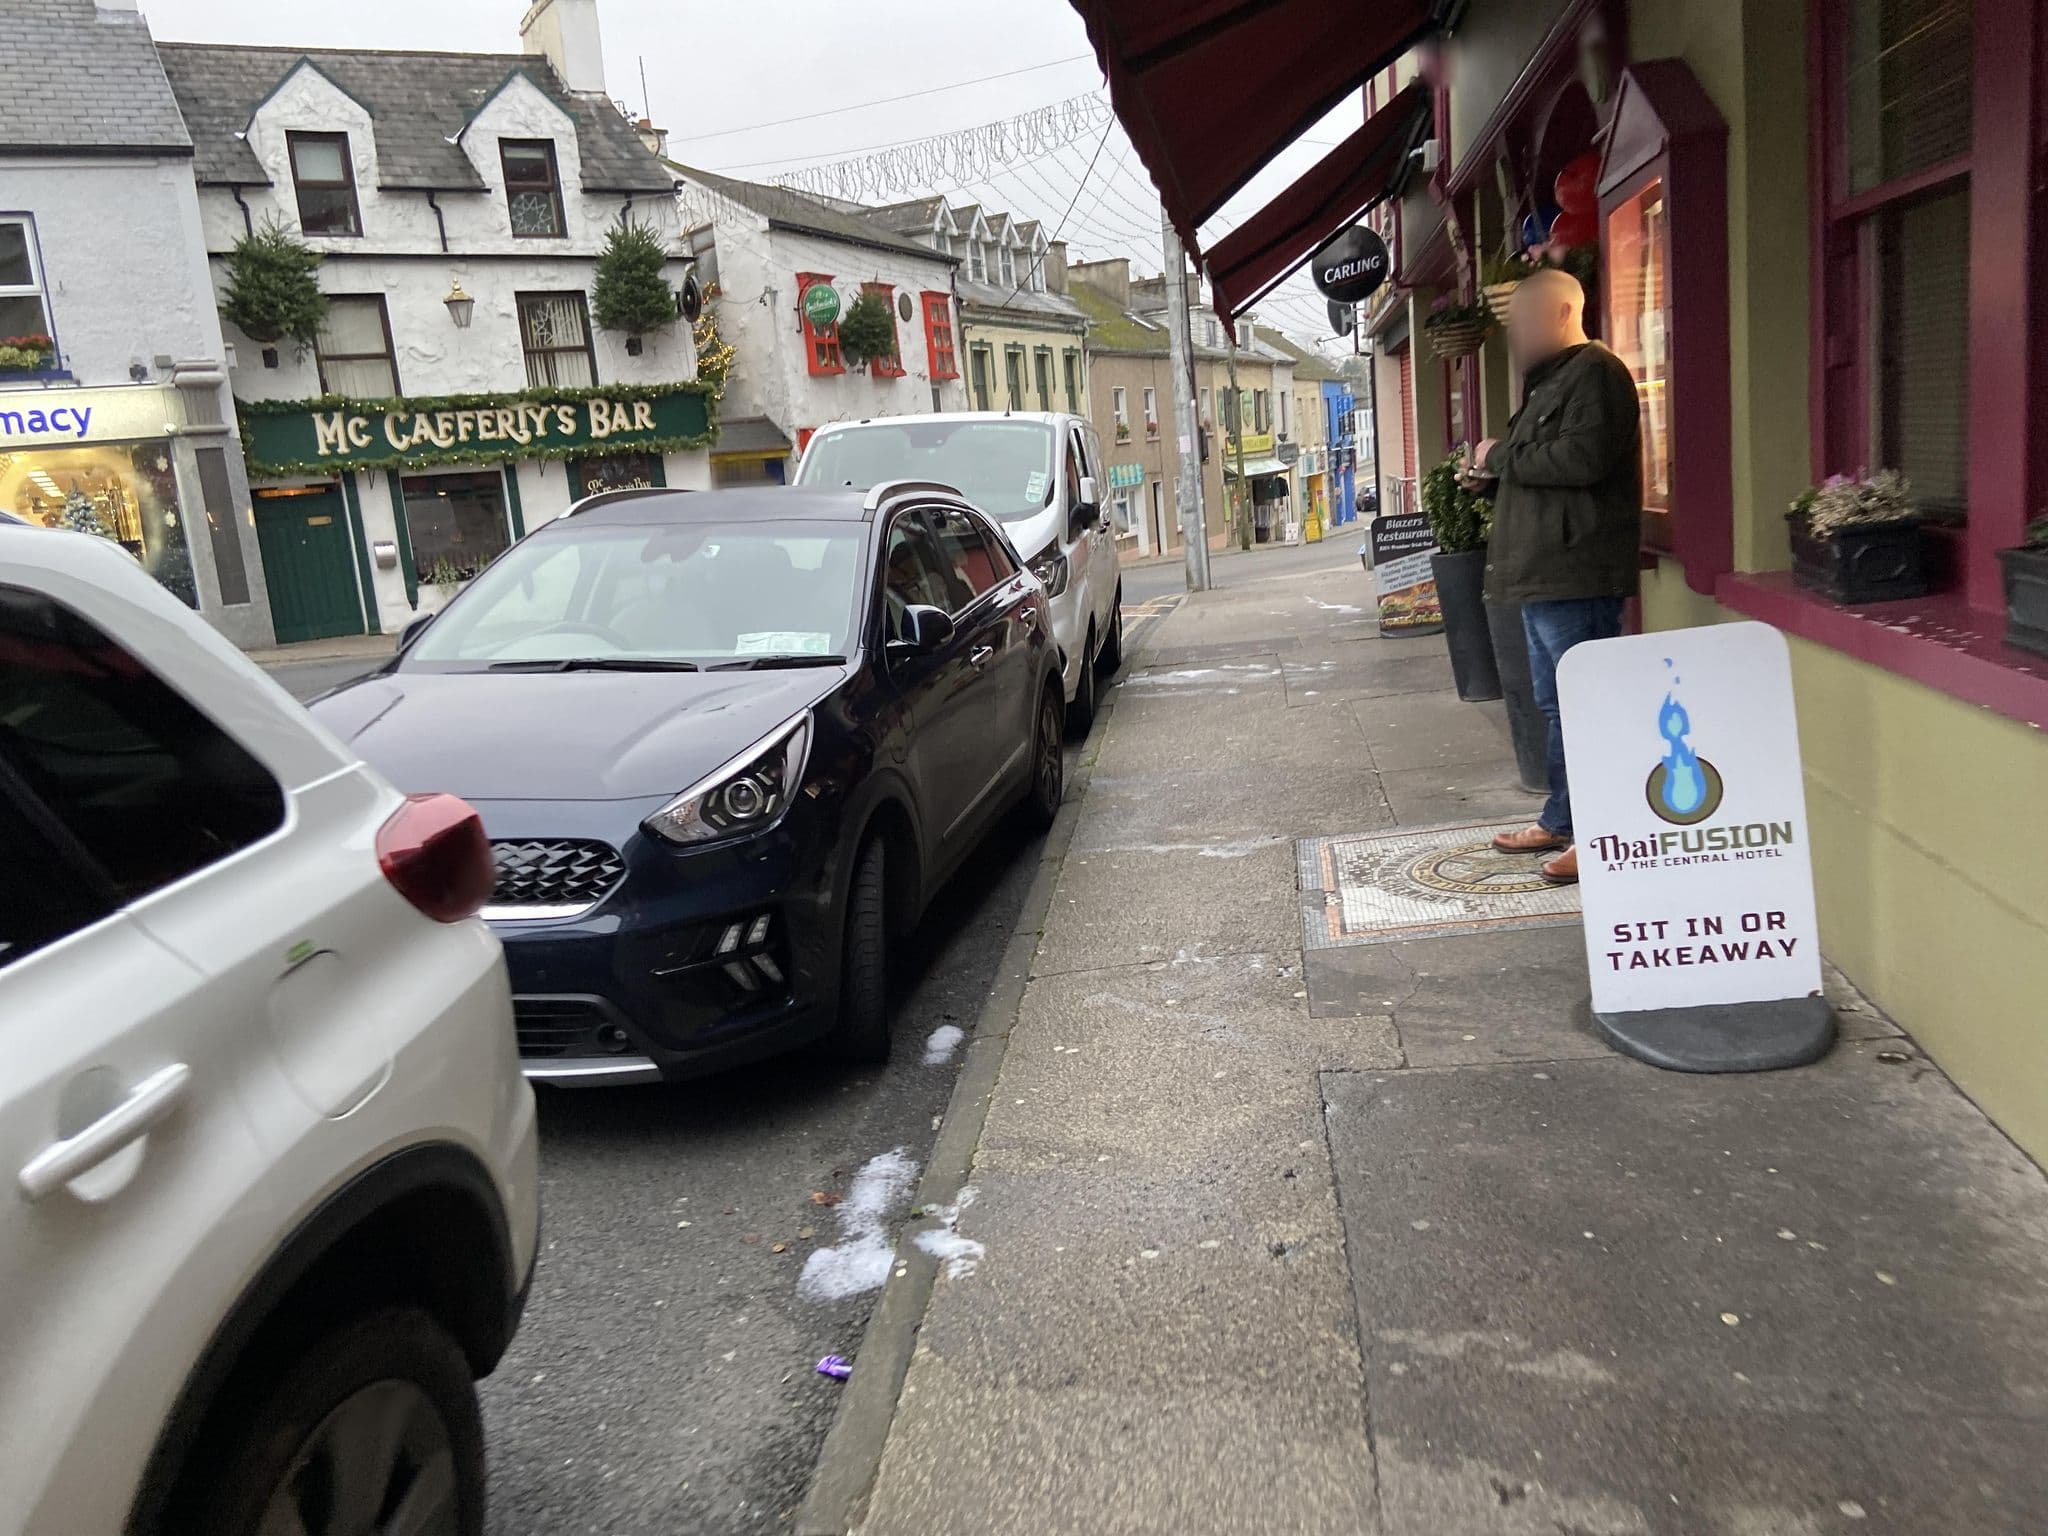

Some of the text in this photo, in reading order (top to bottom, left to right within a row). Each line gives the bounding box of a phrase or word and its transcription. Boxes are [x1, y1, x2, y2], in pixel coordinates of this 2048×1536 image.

[1324, 255, 1380, 284] CARLING
[383, 402, 577, 453] CAFFERTY'S
[587, 398, 657, 439] BAR
[1377, 528, 1434, 543] Restaurant
[1386, 517, 1423, 530] Blazers
[1607, 848, 1783, 872] AT THE CENTRAL HOTEL
[1614, 910, 1787, 943] SIT IN OR
[1607, 938, 1798, 971] TAKEAWAY
